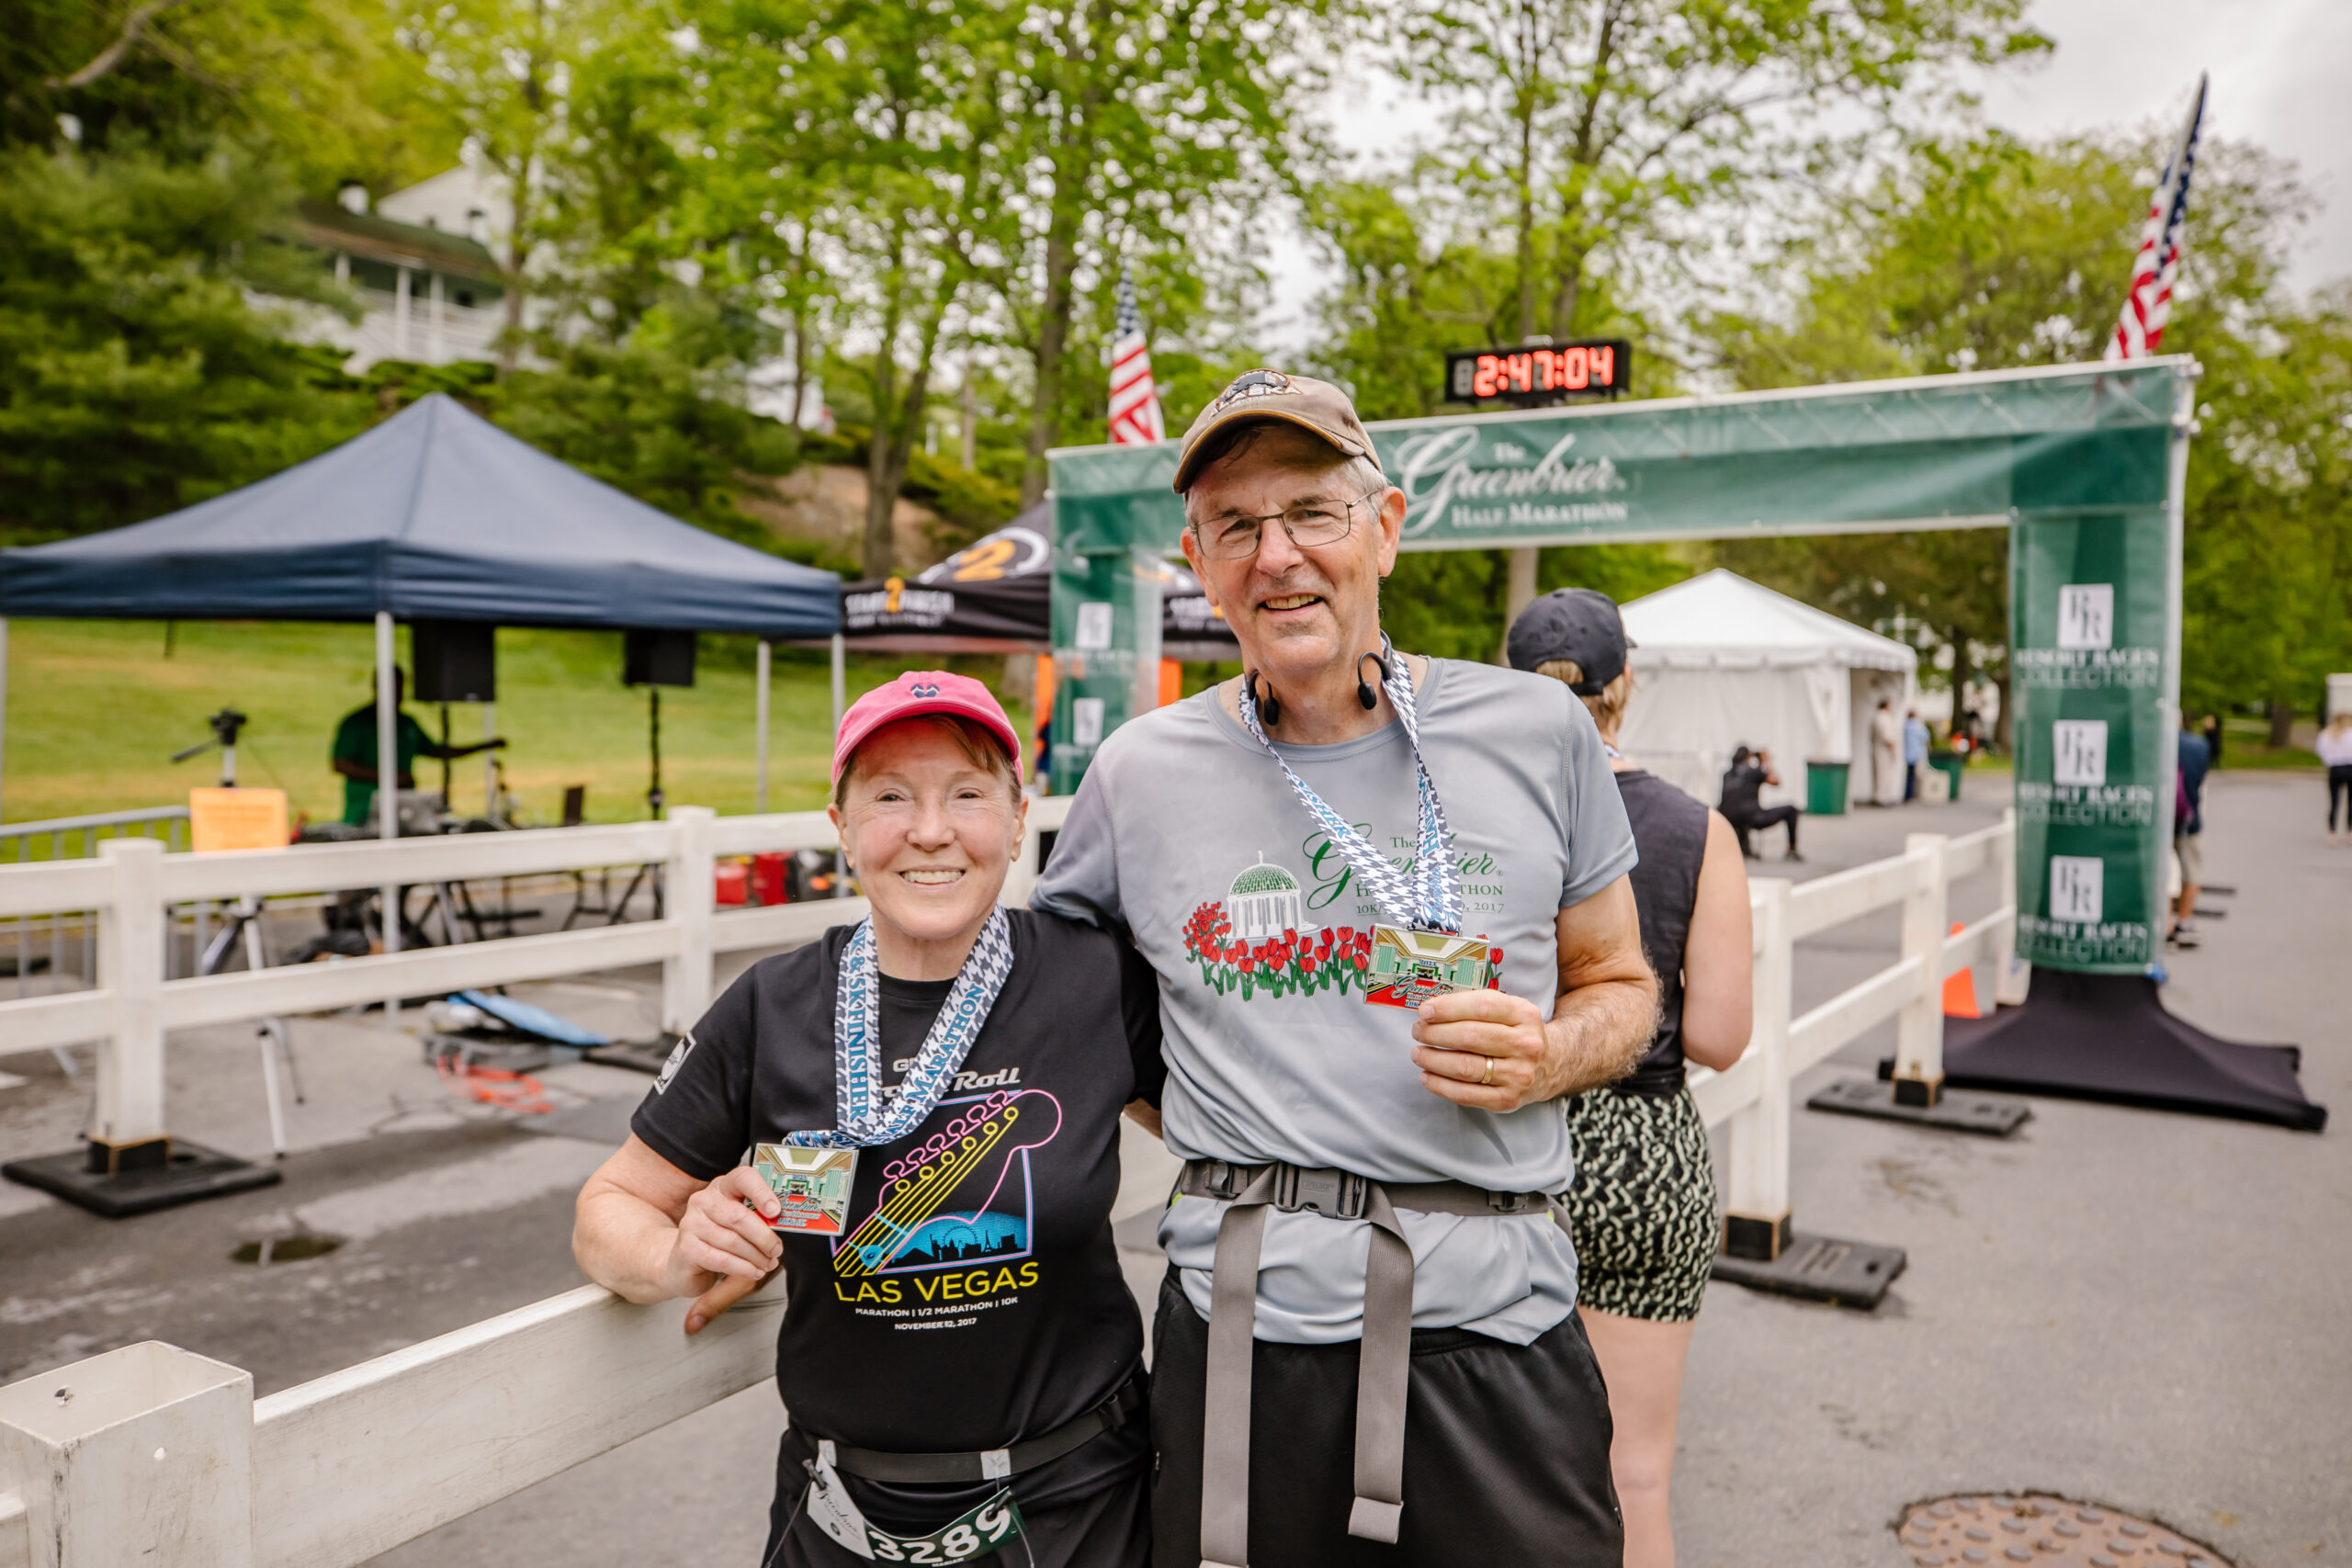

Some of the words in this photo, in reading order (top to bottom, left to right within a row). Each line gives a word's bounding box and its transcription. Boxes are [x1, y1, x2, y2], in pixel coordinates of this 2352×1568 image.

[1474, 345, 1614, 397] 2:47:04
[1390, 837, 1416, 849] The
[1460, 885, 1503, 896] THON
[1475, 902, 1505, 914] 2017
[906, 984, 986, 1102] MARATHON
[847, 1008, 868, 1122] FINISHER
[834, 1280, 902, 1303] LAS
[914, 1261, 1039, 1301] VEGAS
[855, 1307, 910, 1317] MARATHON
[919, 1308, 933, 1317] 1/2
[934, 1301, 993, 1314] MARATHON
[1001, 1296, 1018, 1306] 10K
[894, 1321, 944, 1330] NOVEMBER
[957, 1317, 978, 1326] 2017
[868, 1503, 1011, 1564] 3289
